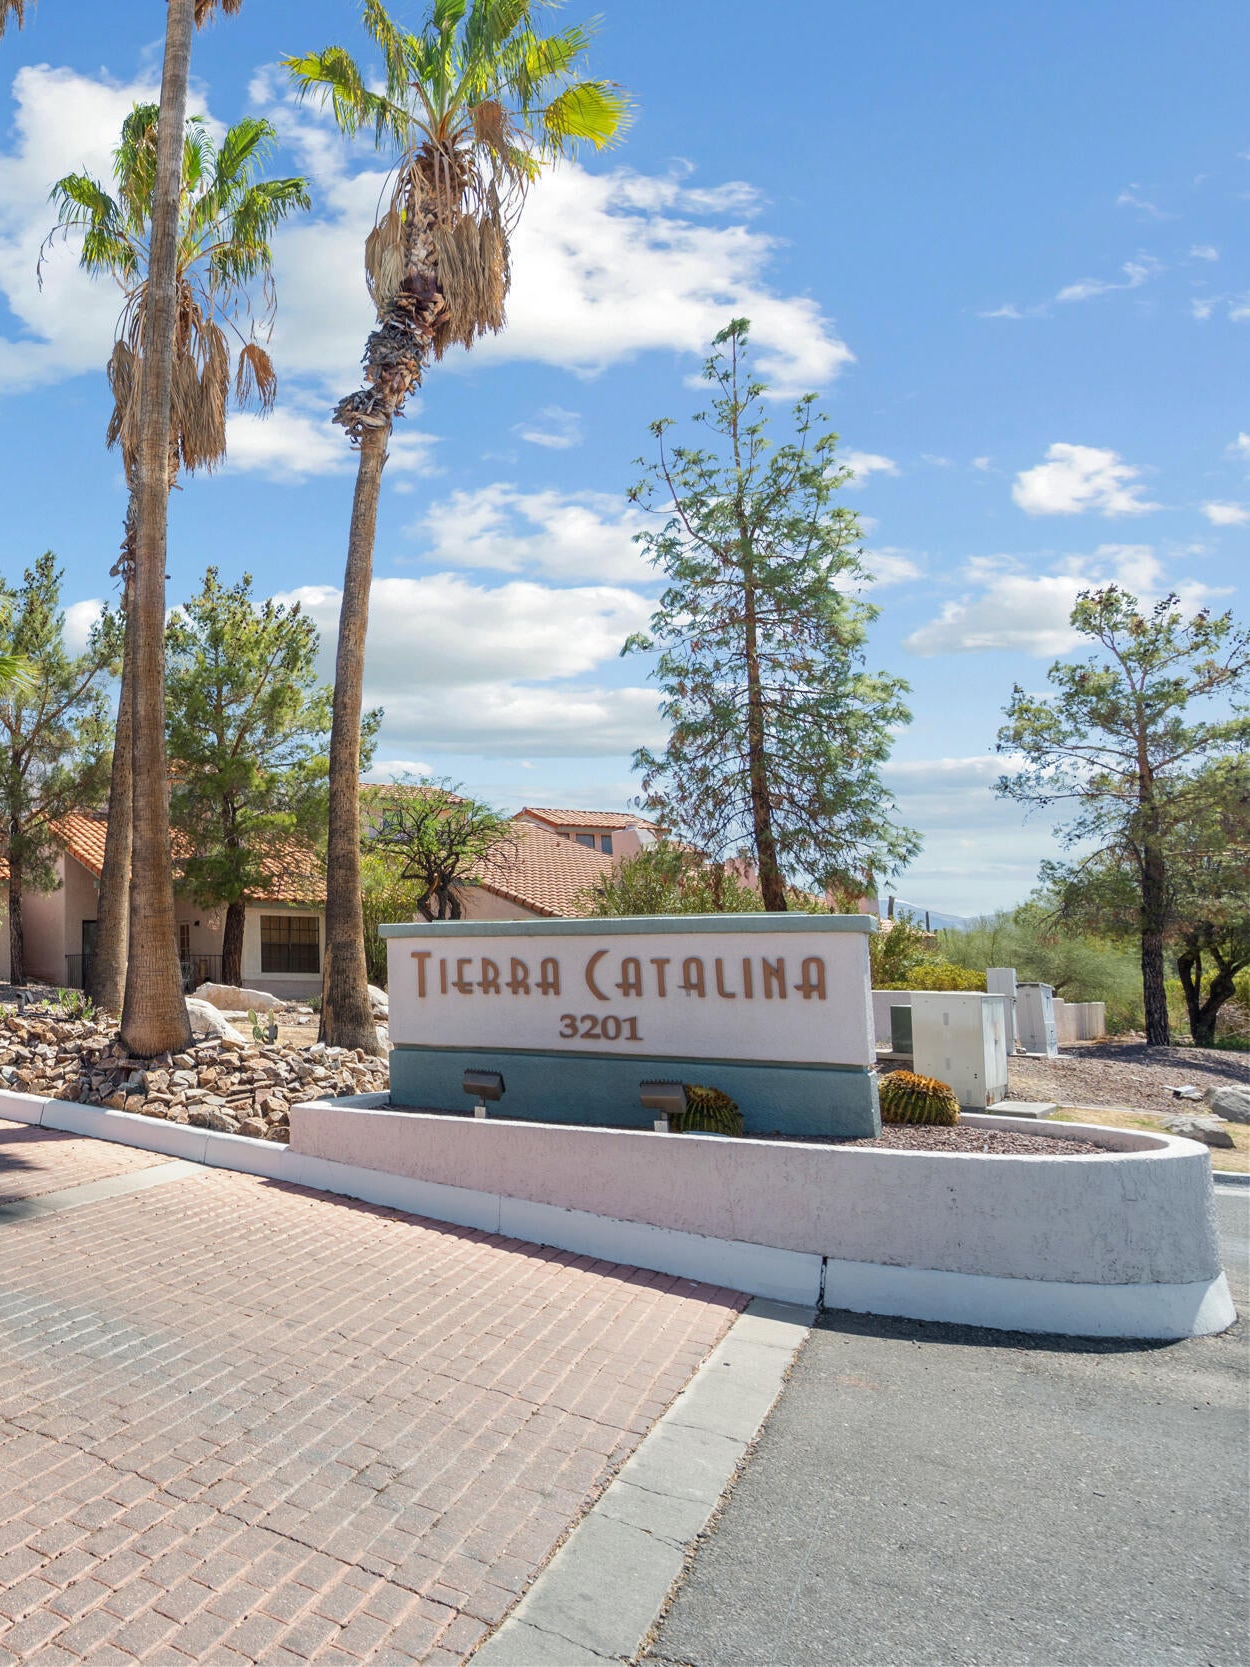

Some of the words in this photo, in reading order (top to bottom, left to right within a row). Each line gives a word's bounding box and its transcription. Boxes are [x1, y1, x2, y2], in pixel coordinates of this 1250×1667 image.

[411, 951, 561, 998] TIERRA
[584, 949, 828, 1001] CATALINA
[558, 1014, 645, 1042] 3201
